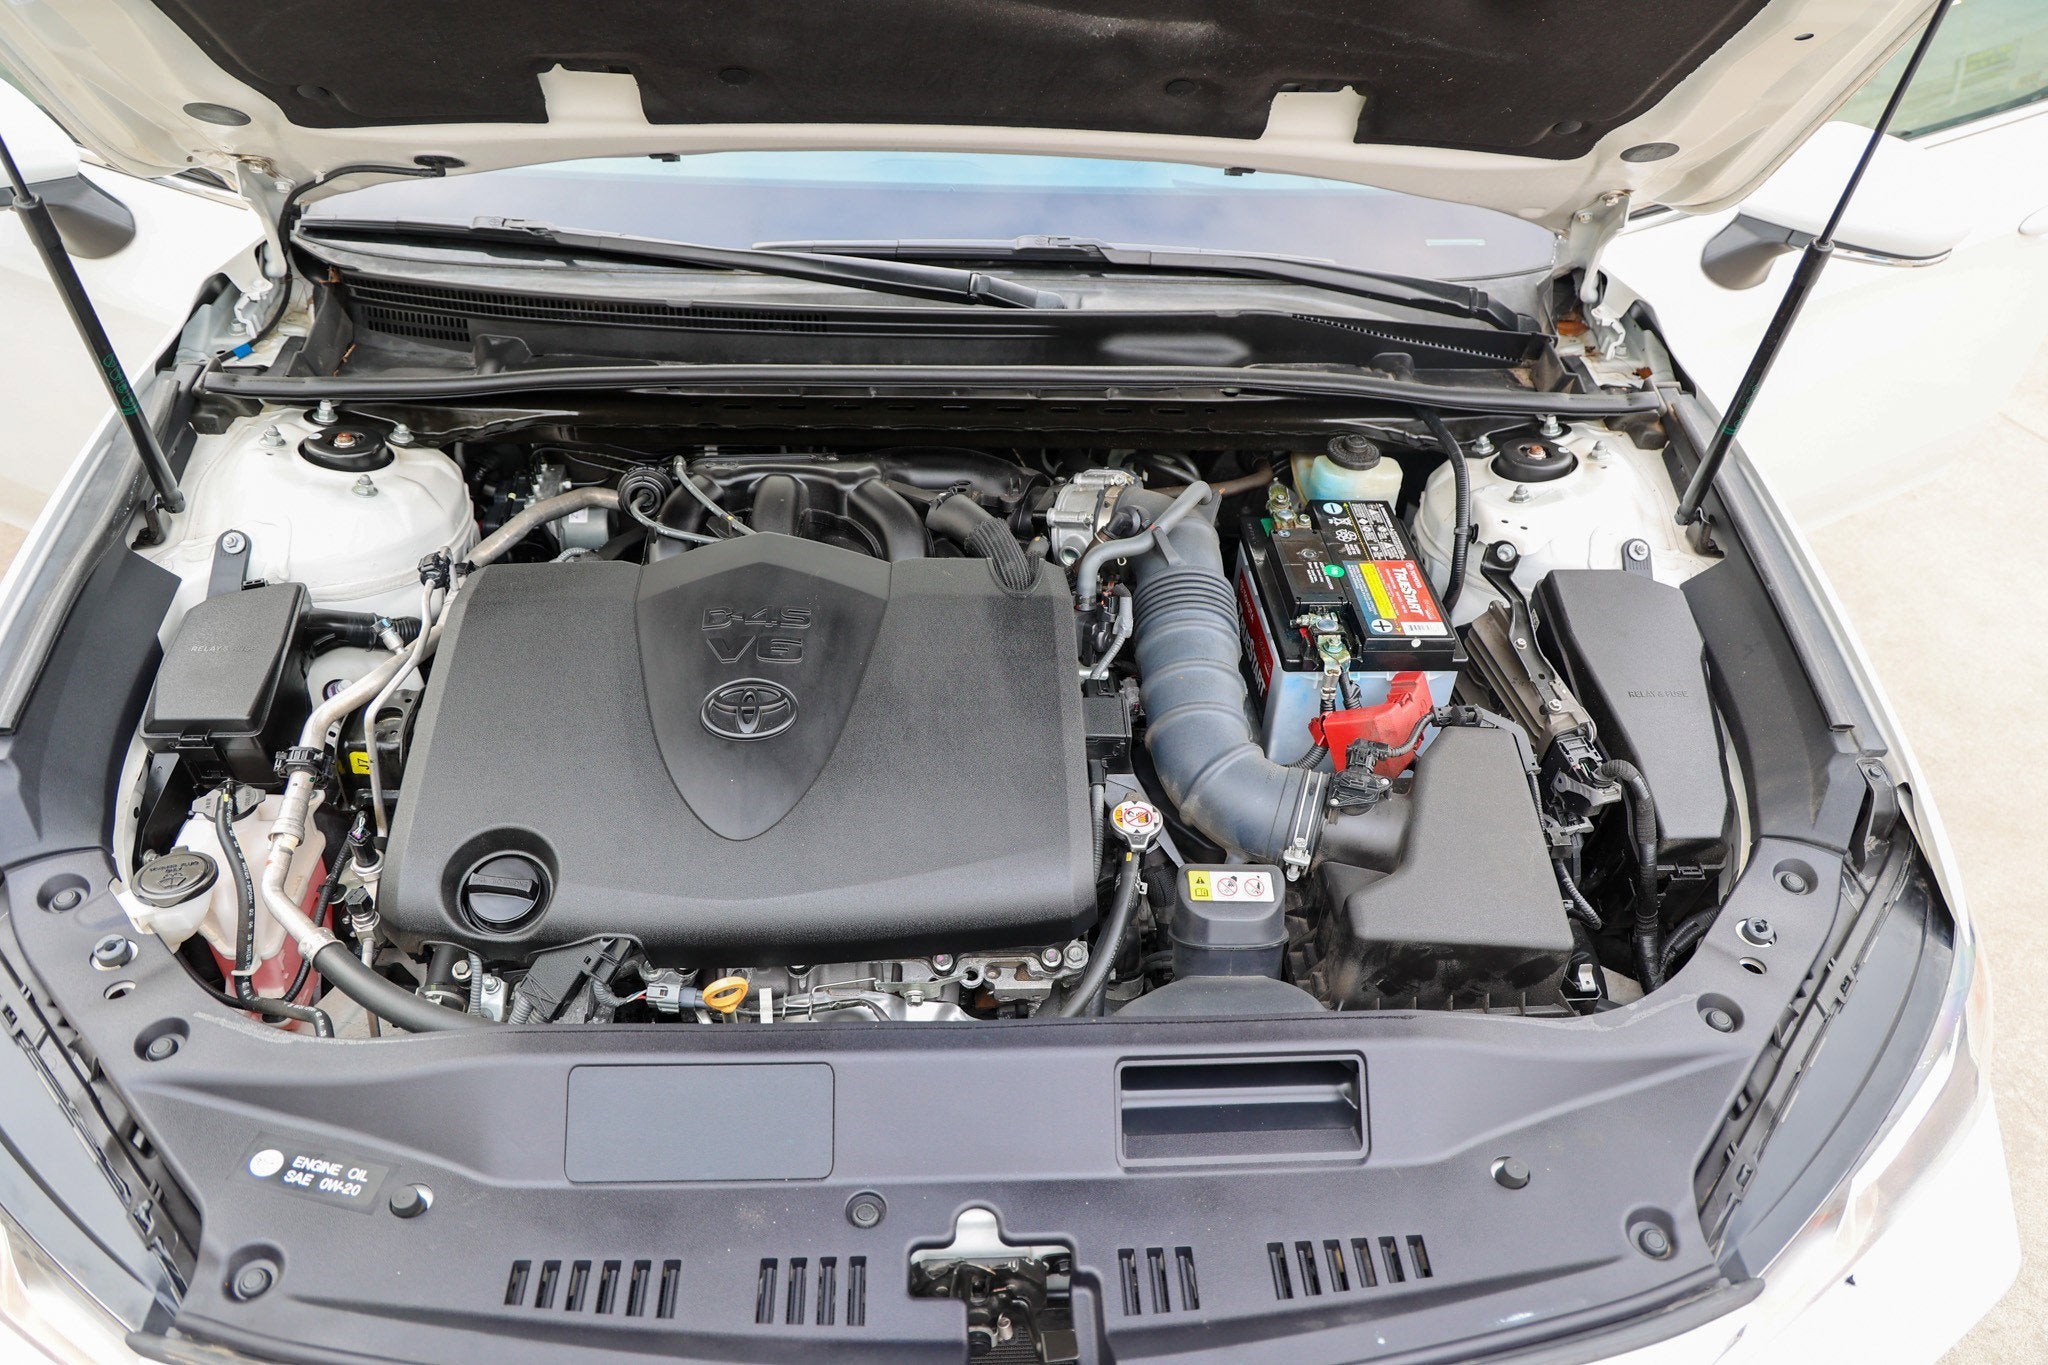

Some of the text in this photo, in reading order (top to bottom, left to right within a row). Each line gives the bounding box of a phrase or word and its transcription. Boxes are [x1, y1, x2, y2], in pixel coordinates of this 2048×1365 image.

[190, 644, 222, 652] RELAY
[705, 633, 804, 665] V6
[1628, 690, 1655, 698] RELAY
[1665, 690, 1688, 698] FUSE
[292, 1156, 343, 1176] ENGINE
[347, 1168, 368, 1182] OIL
[283, 1170, 362, 1196] SAE 0W-20
